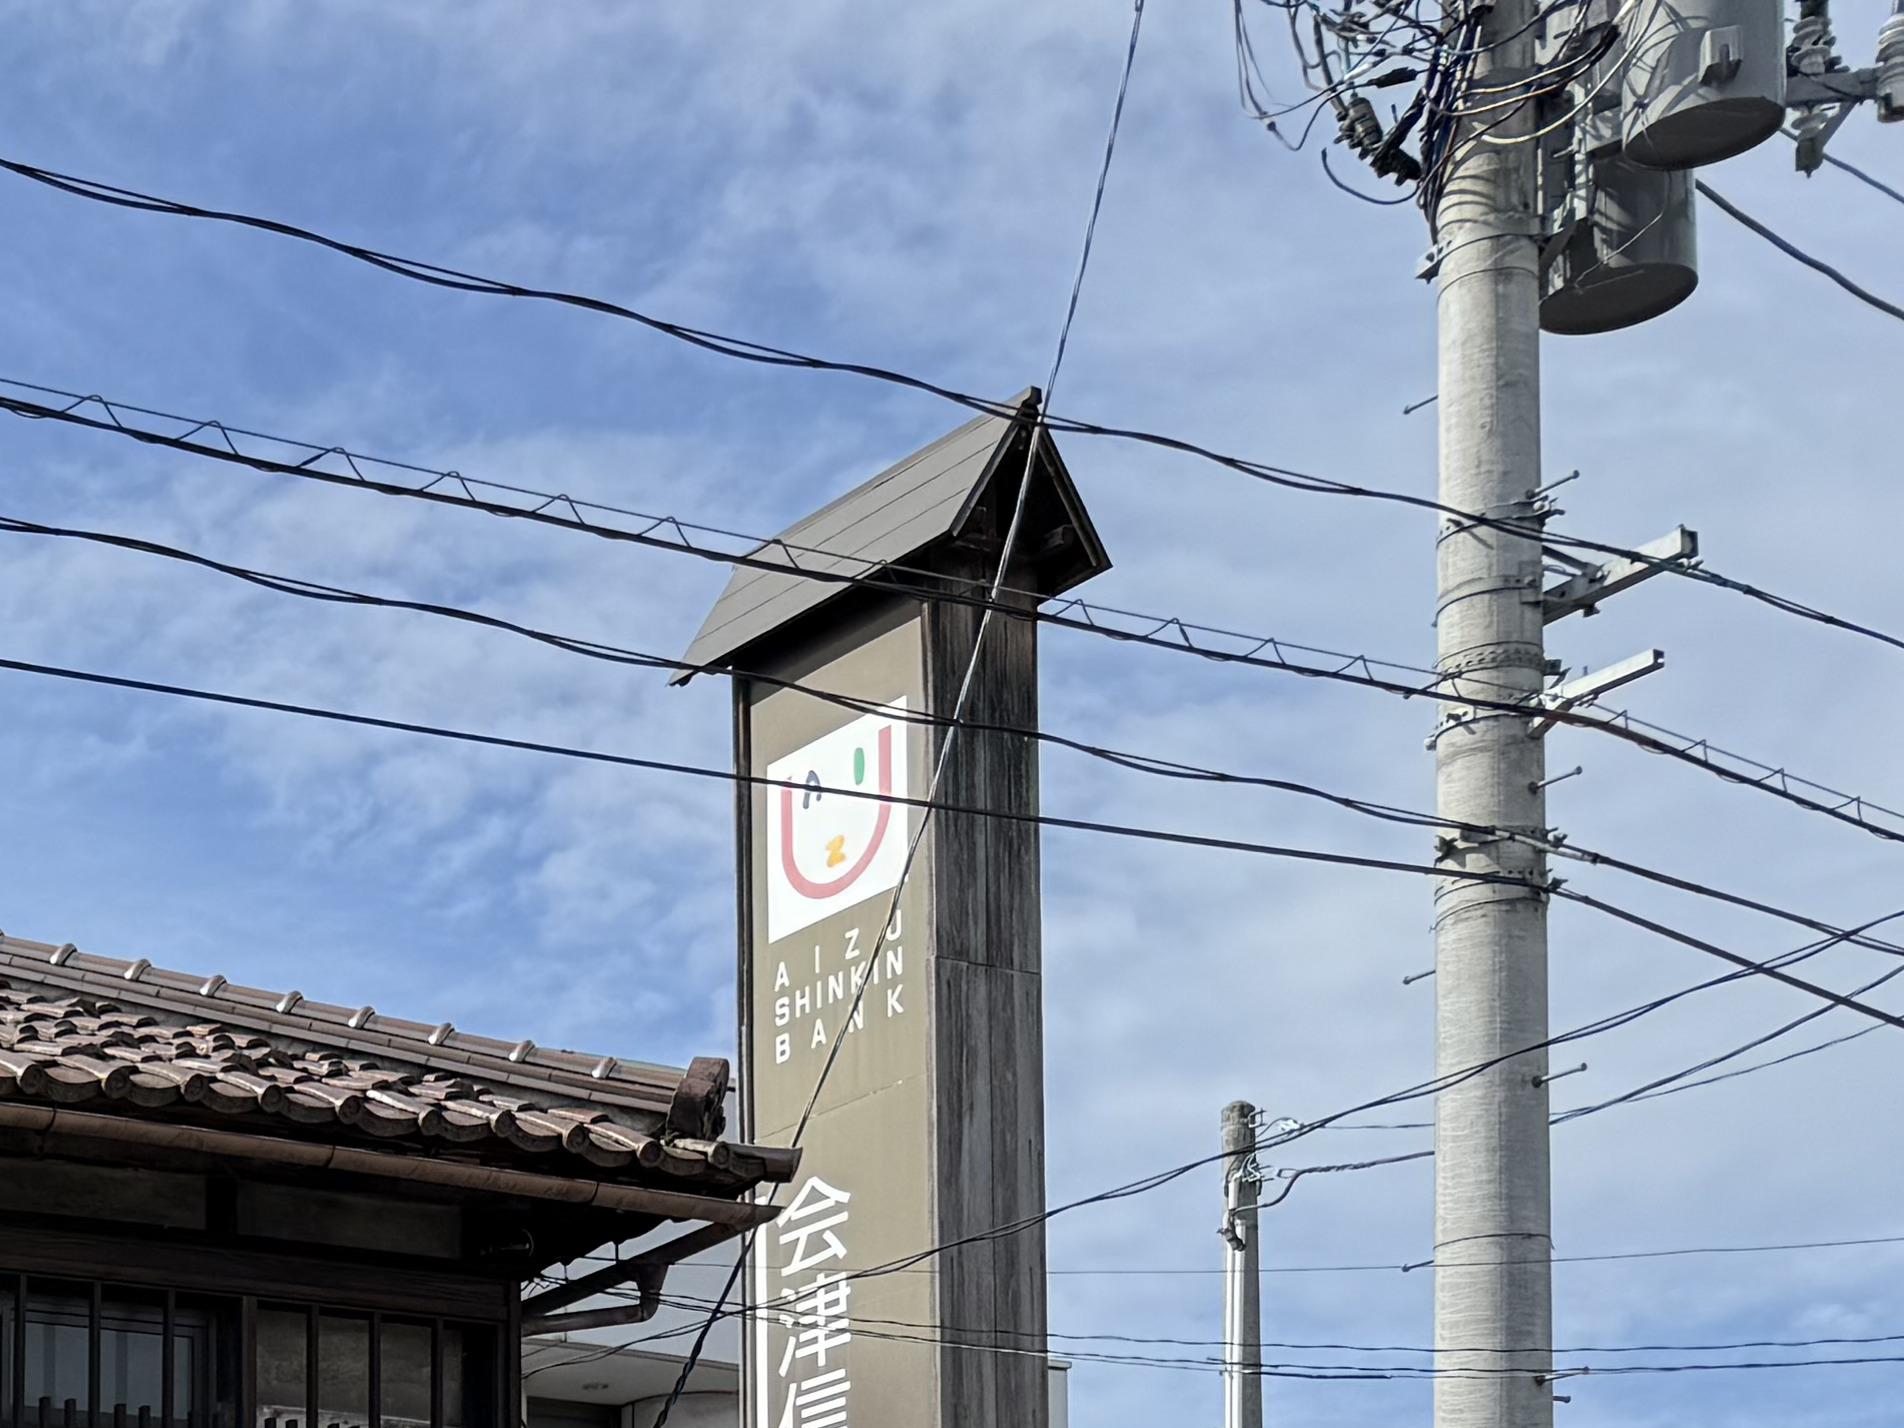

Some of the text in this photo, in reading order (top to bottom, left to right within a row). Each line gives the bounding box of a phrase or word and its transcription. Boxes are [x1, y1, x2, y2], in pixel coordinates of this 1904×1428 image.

[774, 909, 904, 993] AIZU
[774, 945, 904, 1028] SHINKIN
[774, 984, 904, 1066] BANK
